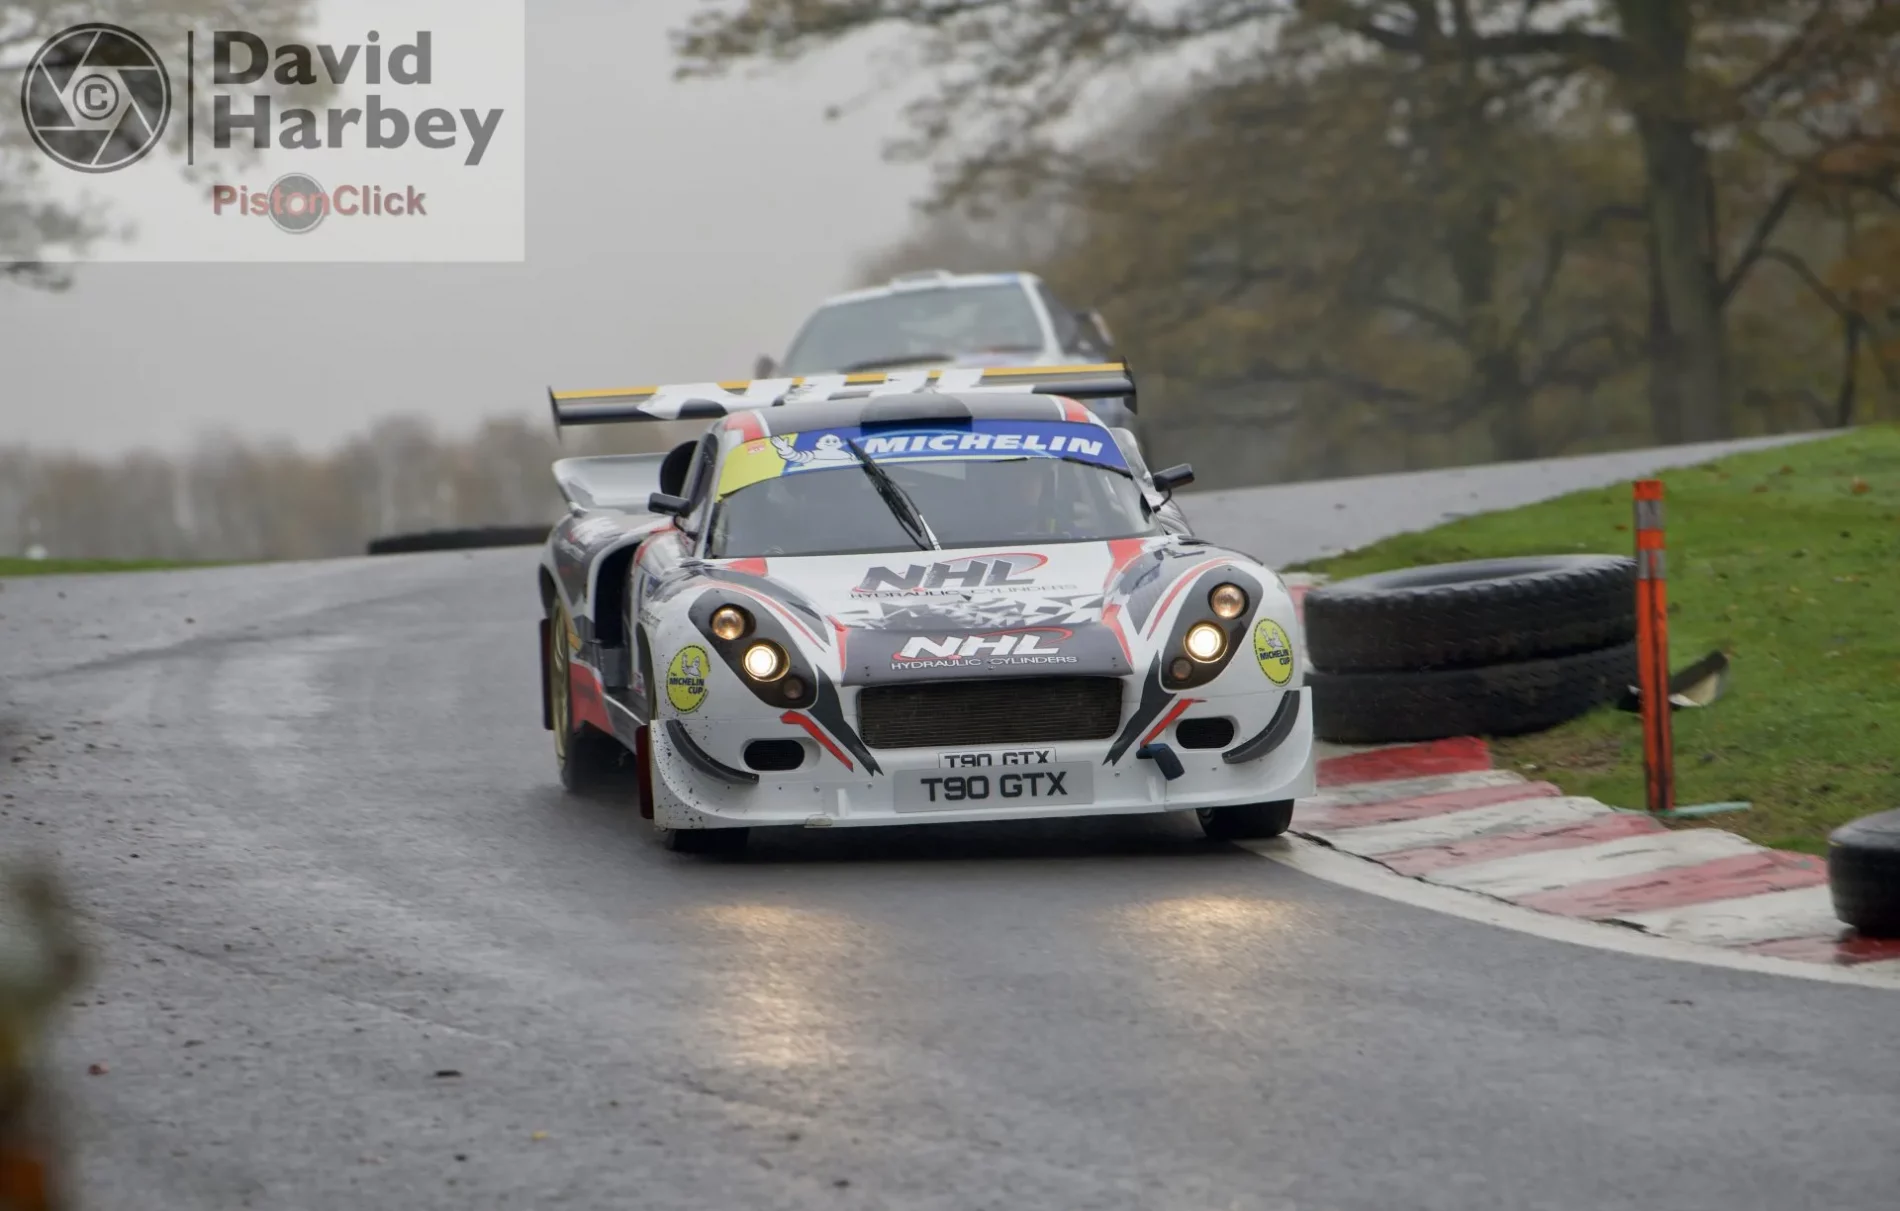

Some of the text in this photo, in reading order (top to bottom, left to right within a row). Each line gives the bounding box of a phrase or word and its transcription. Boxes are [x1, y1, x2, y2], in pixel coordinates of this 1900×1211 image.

[864, 434, 1103, 456] MICHELIN
[858, 559, 1036, 590] NHL
[850, 584, 1078, 599] HYDRAULIC CYLINDERS
[899, 633, 1061, 658] NHL
[891, 655, 1078, 670] HYDRAULIC CYLINDERS
[669, 677, 704, 686] MICHELIN
[688, 686, 703, 694] CUP
[920, 771, 1068, 802] T90 GTX
